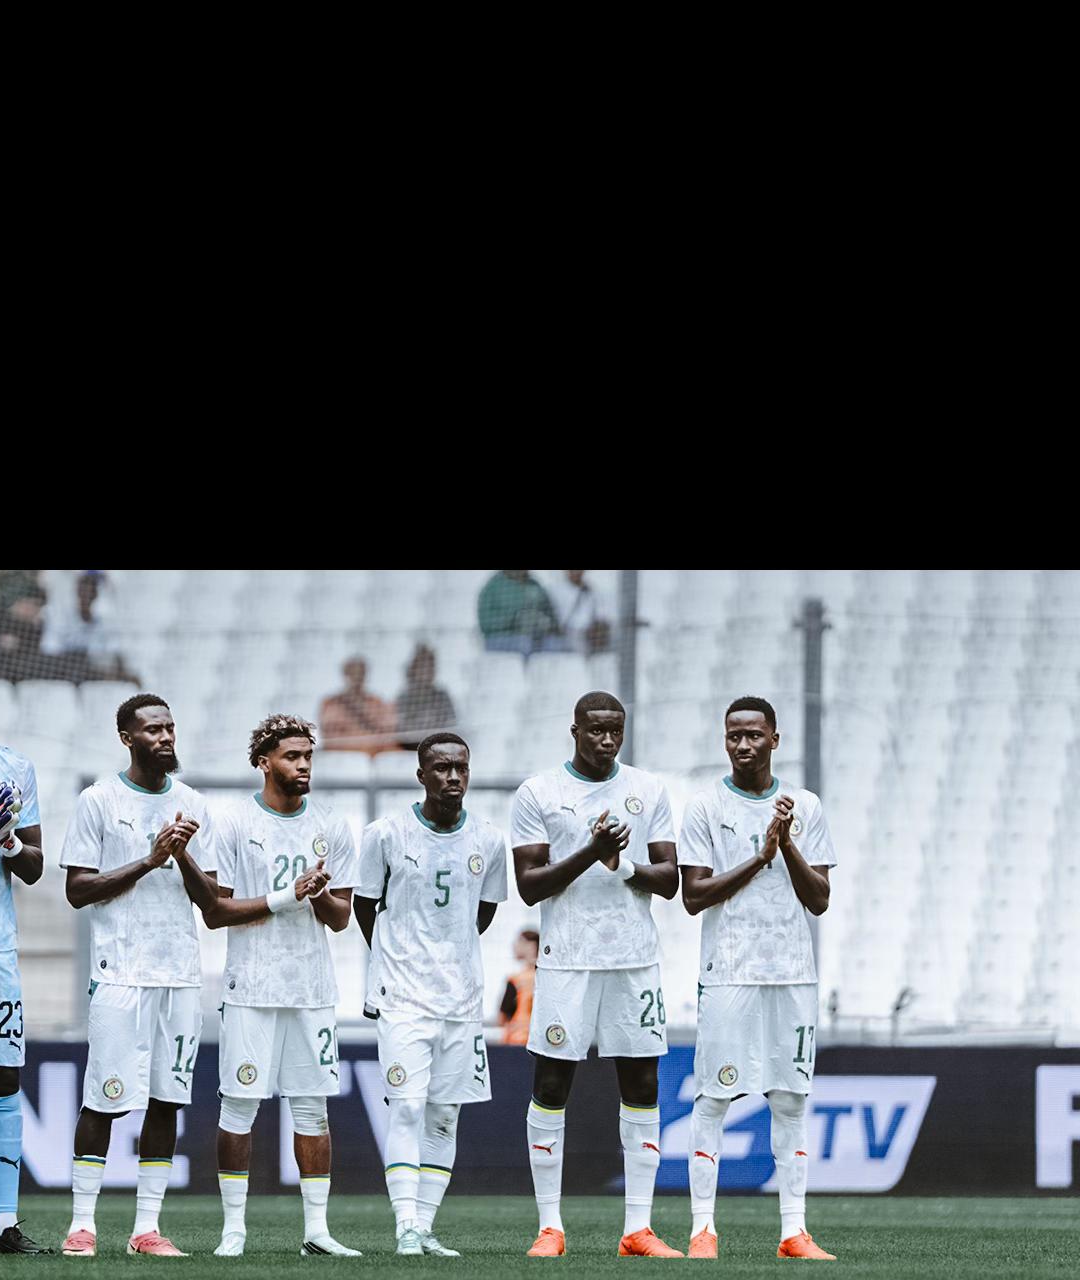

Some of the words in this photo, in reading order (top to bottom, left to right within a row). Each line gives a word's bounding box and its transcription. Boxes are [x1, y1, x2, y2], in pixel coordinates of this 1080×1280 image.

[434, 870, 451, 908] 5
[639, 987, 666, 1028] 28
[171, 1035, 195, 1073] 12
[318, 1025, 338, 1066] 2
[474, 1034, 486, 1073] 5
[813, 1105, 909, 1160] TV
